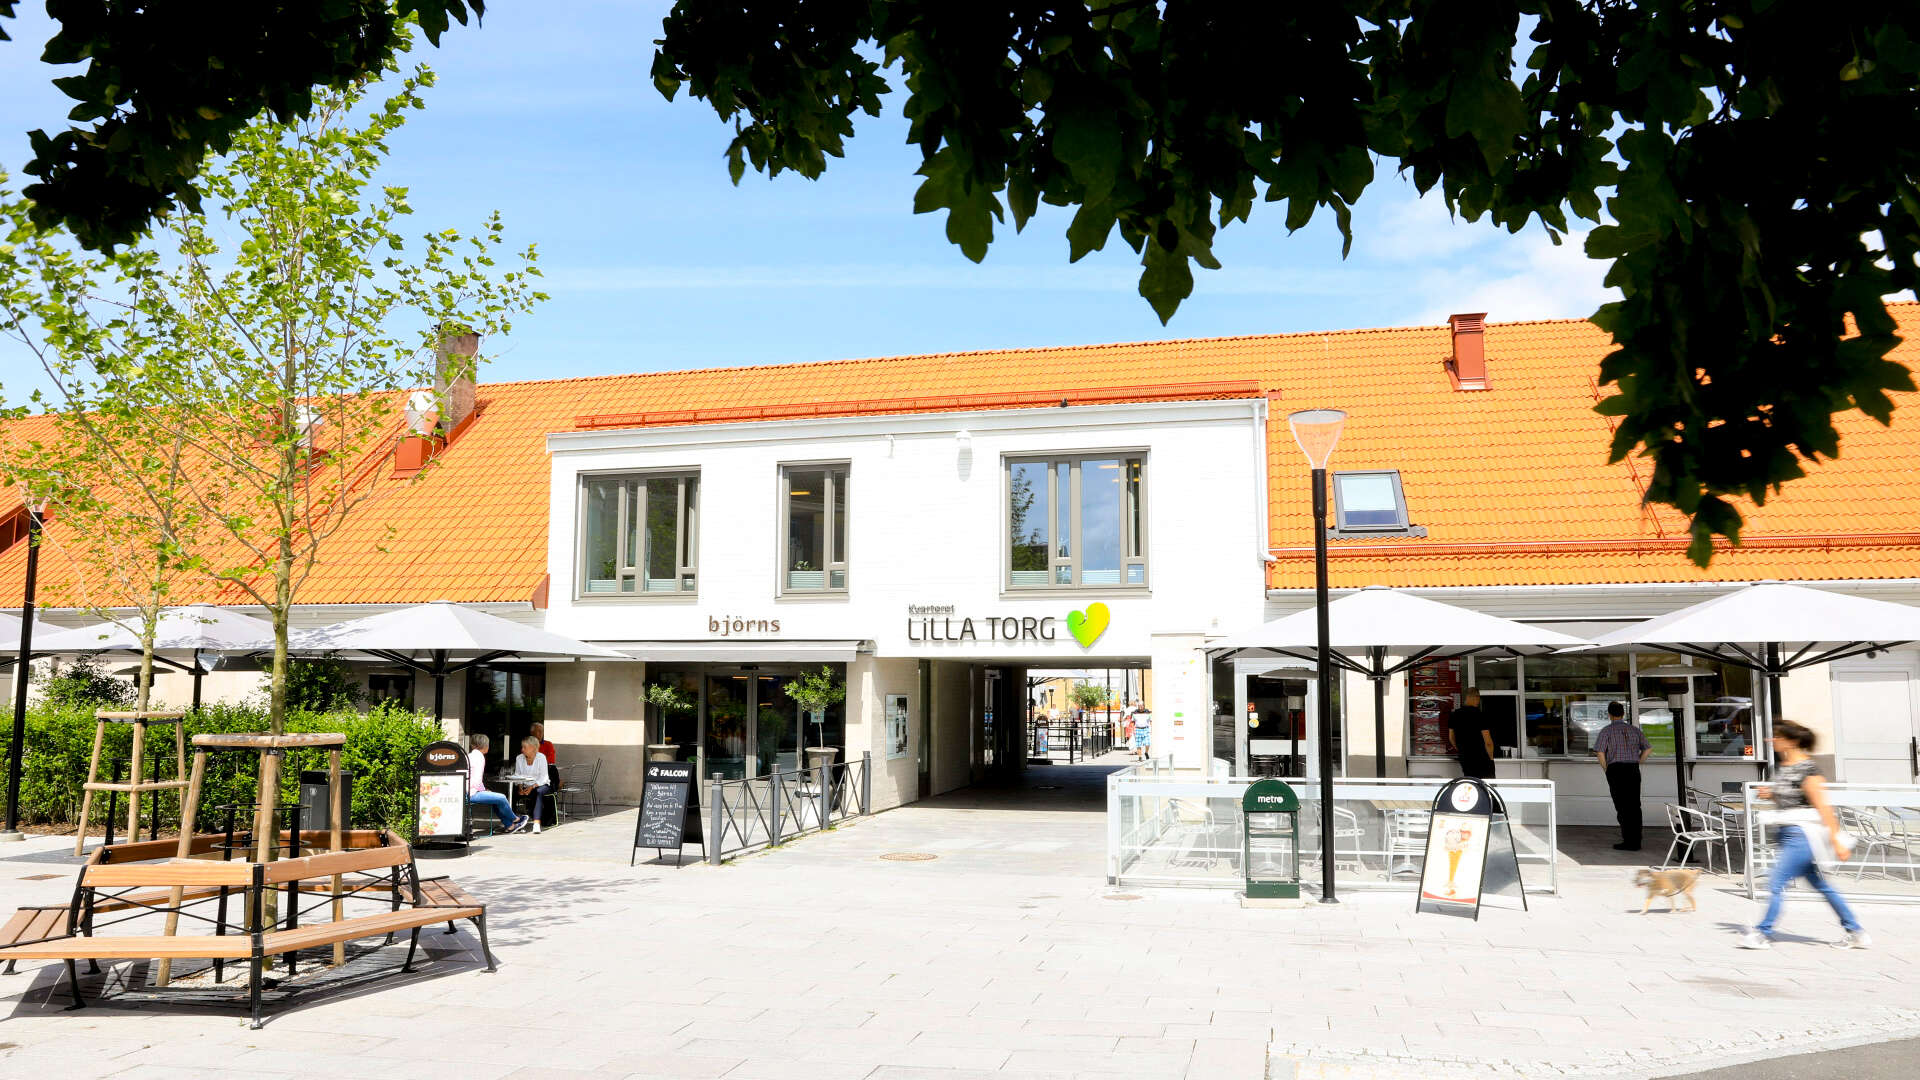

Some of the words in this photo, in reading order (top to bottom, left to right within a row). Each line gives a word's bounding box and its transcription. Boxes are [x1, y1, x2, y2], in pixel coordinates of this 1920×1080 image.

[908, 603, 954, 614] Kvarteret
[709, 614, 780, 636] björns
[985, 617, 1055, 641] TORG
[429, 753, 456, 762] björns
[660, 769, 689, 777] FALCON
[1257, 795, 1284, 804] metro
